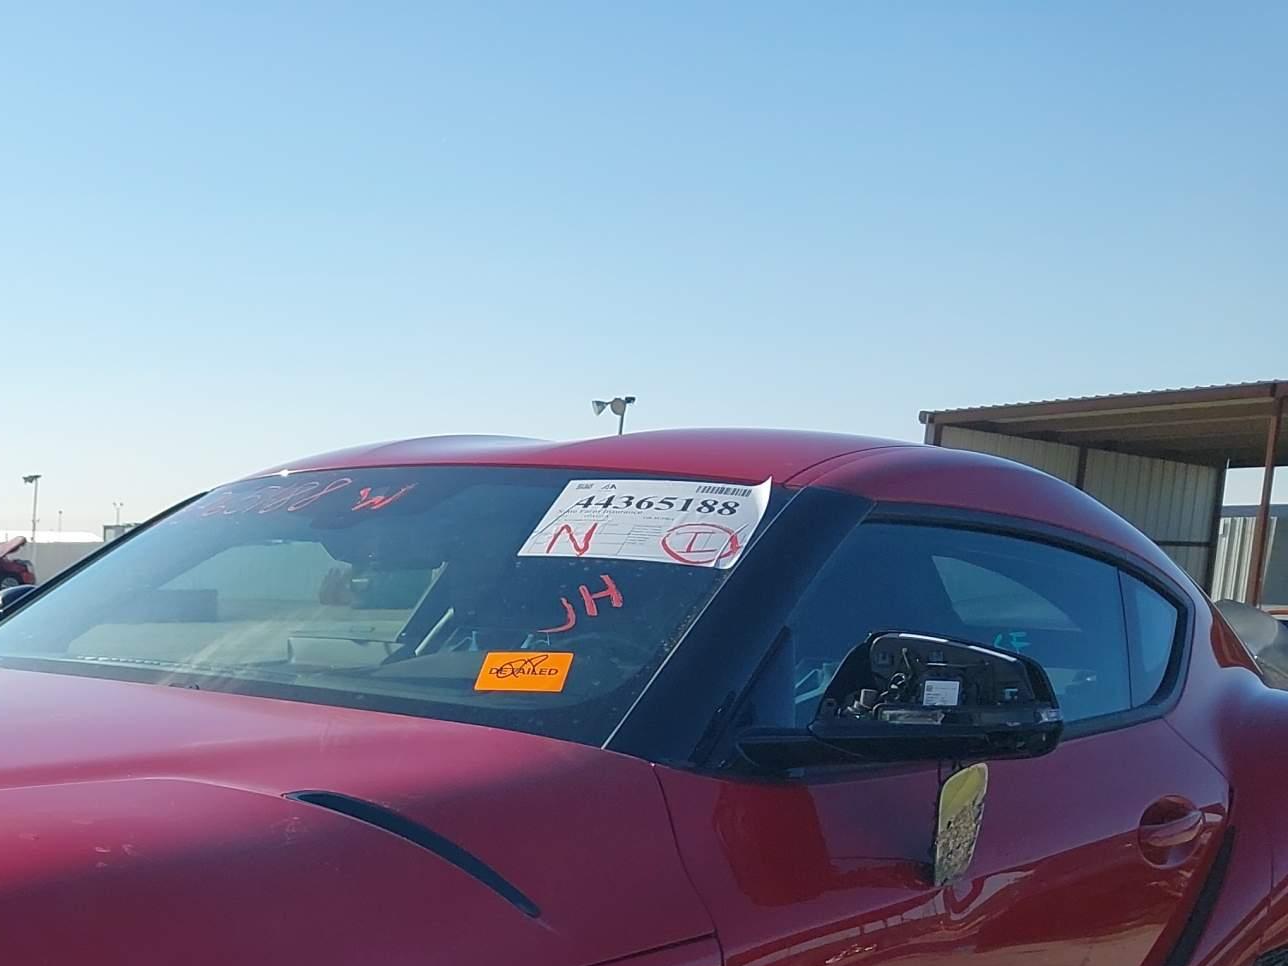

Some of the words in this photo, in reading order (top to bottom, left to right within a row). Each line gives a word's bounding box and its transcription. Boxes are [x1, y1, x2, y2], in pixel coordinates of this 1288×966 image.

[575, 495, 741, 516] 44365188
[545, 522, 599, 557] N
[488, 667, 559, 676] DETAILED
